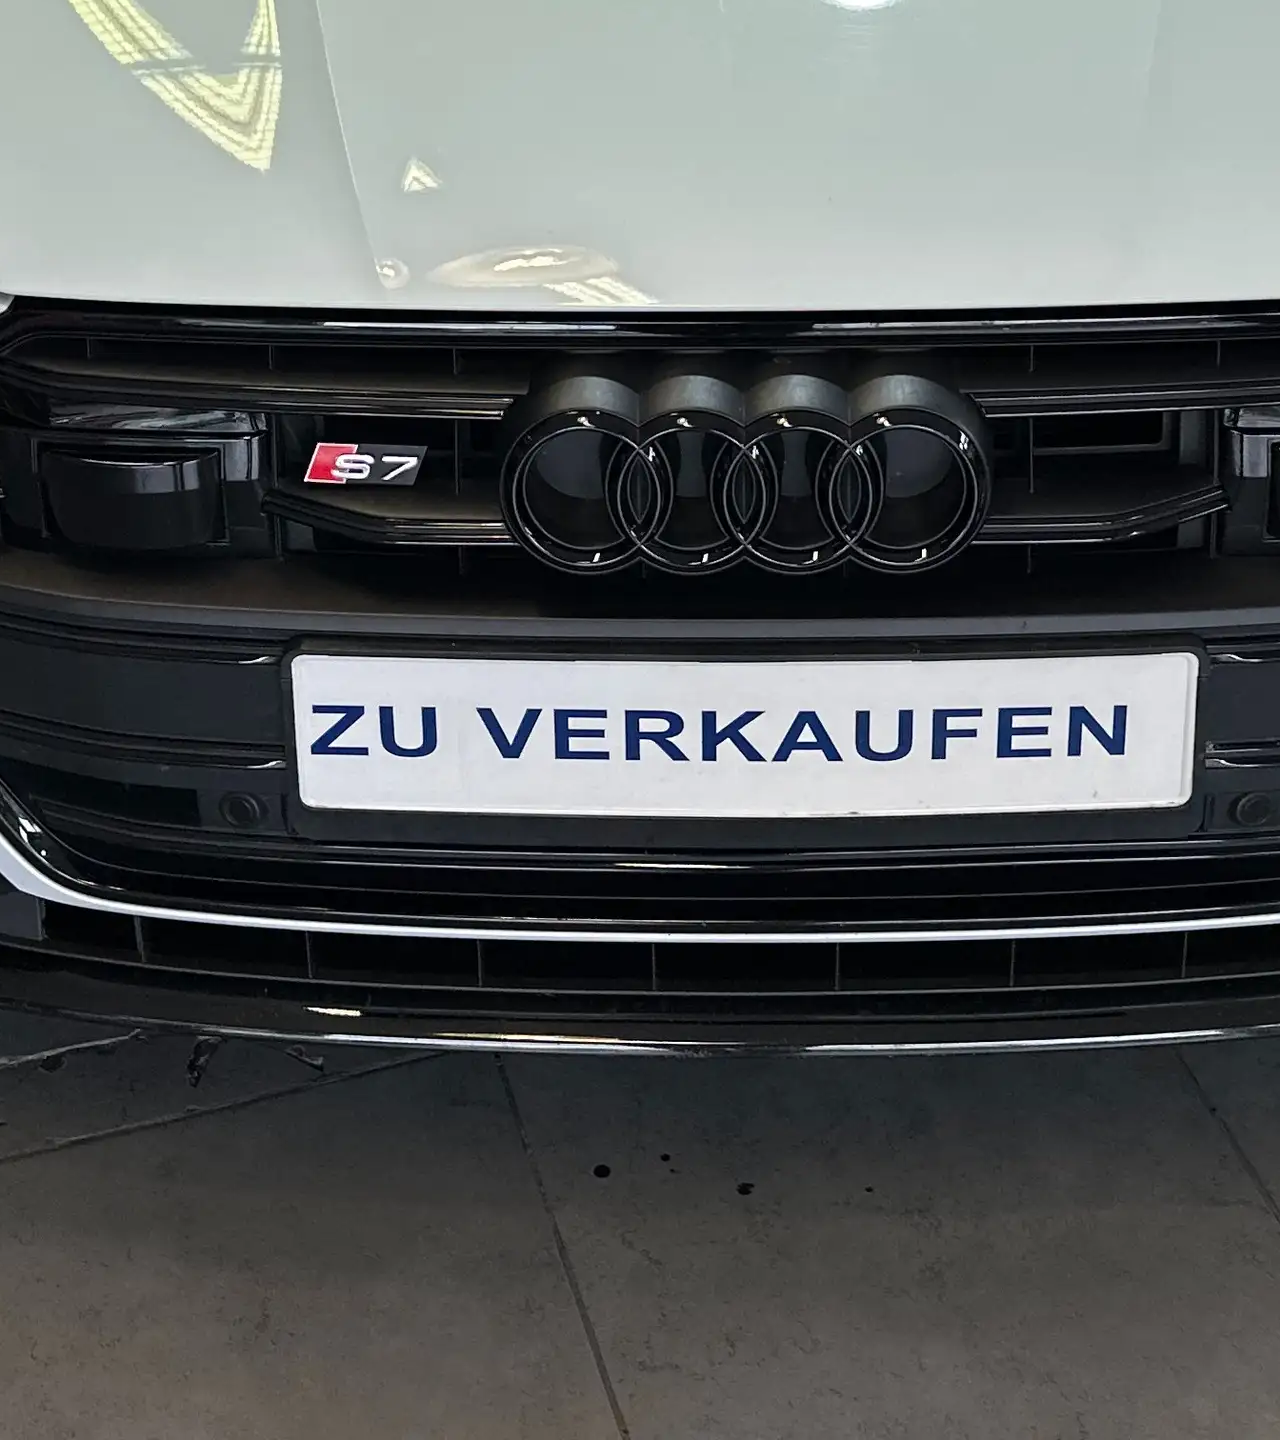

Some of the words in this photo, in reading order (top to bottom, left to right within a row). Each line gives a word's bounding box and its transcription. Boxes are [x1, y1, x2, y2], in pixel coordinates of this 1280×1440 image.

[329, 453, 419, 481] S7
[310, 704, 438, 758] ZU
[475, 704, 1130, 763] VERKAUFEN
